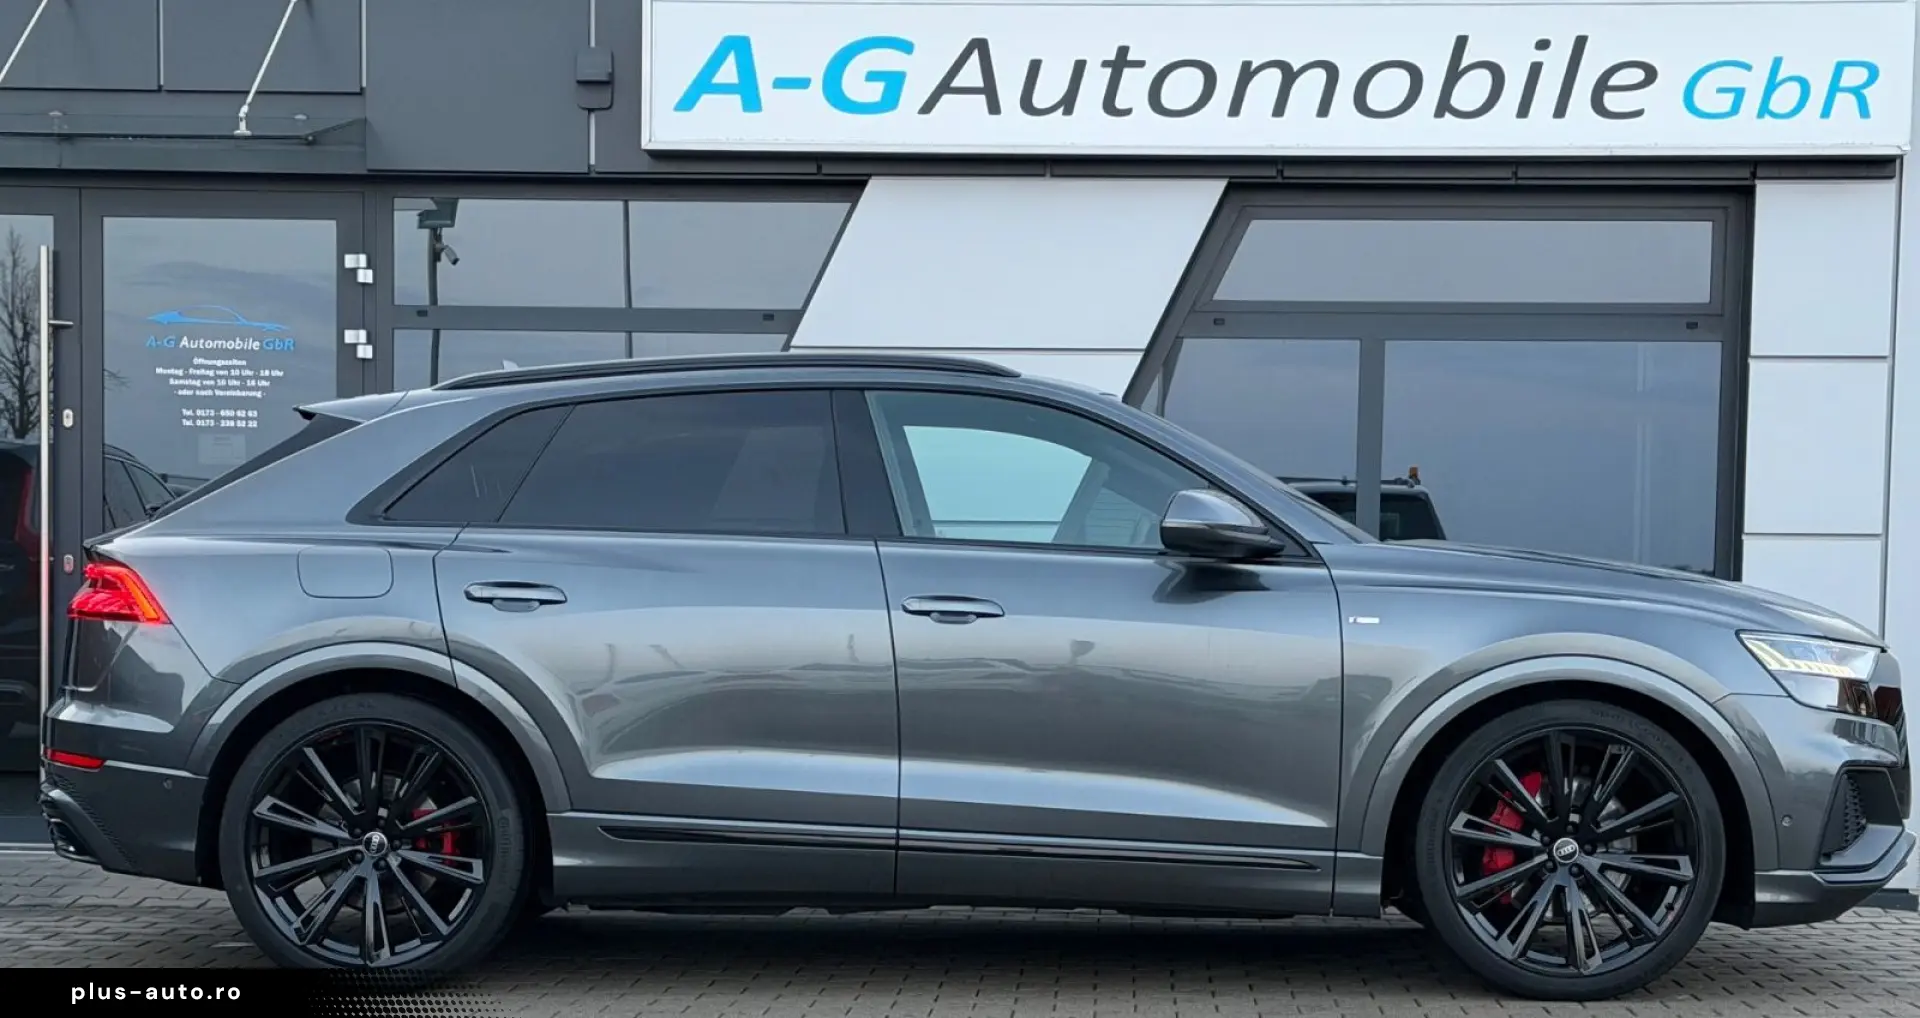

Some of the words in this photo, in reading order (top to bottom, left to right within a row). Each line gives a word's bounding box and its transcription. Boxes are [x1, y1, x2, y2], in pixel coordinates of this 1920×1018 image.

[673, 34, 916, 116] A-G
[917, 35, 1659, 120] Automobile
[1681, 59, 1881, 120] GbR
[145, 335, 177, 348] A-G
[179, 335, 261, 351] Automobile
[262, 336, 296, 351] GbR
[188, 367, 215, 377] Freitag
[241, 369, 255, 377] Uhr
[271, 369, 284, 377] Uhr
[169, 378, 201, 387] Samstag
[257, 379, 270, 387] Uhr
